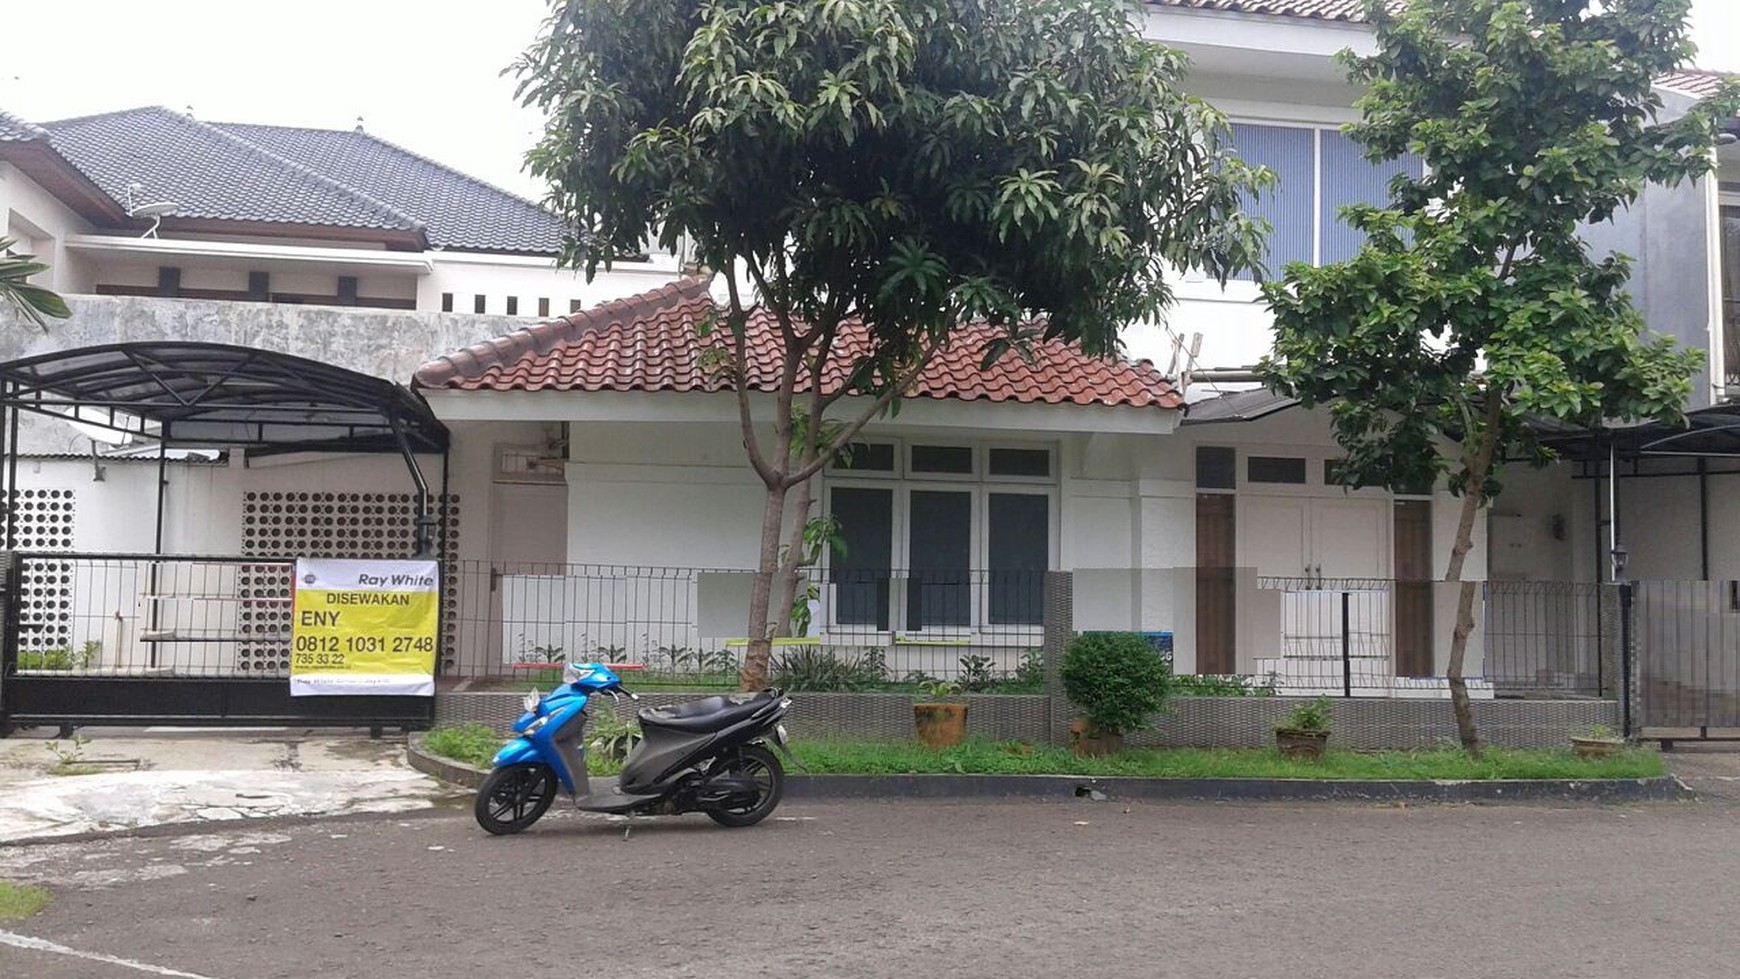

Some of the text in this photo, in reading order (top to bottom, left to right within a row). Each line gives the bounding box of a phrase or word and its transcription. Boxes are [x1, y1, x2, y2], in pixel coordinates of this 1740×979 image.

[358, 573, 434, 587] Ray White
[327, 593, 410, 605] DISEWAKAN
[301, 610, 340, 626] ENY
[296, 636, 433, 652] 0812 1031 2748
[296, 653, 345, 664] 735 33 22
